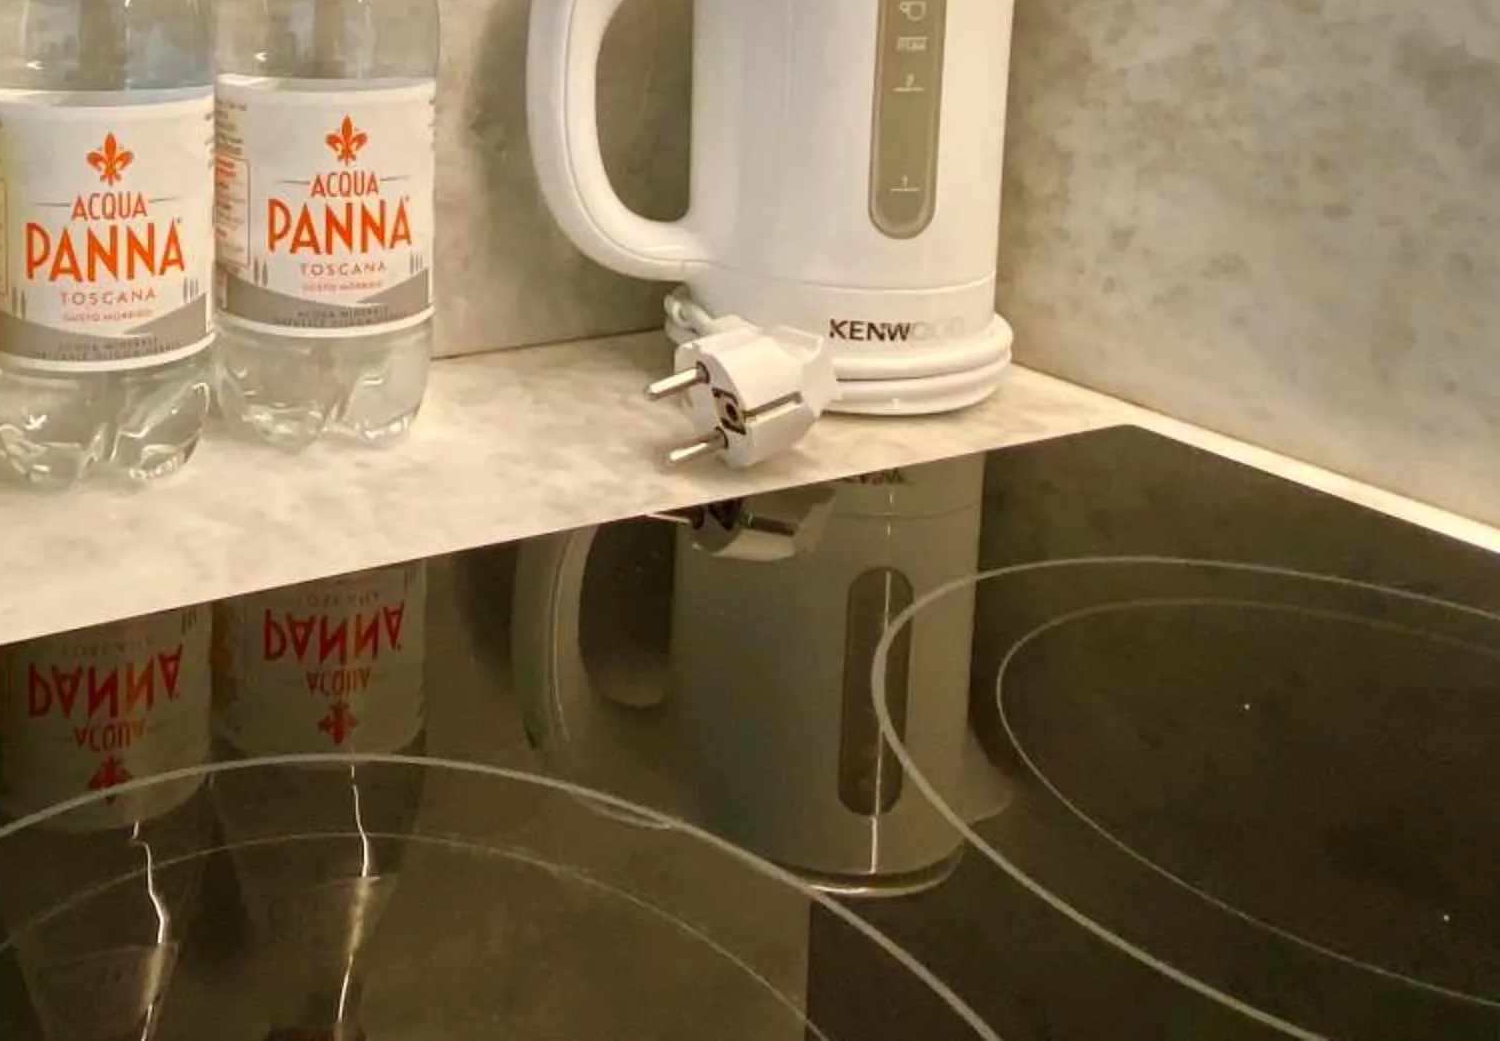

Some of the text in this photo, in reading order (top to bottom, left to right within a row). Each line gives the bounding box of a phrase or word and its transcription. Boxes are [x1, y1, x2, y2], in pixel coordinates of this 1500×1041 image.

[310, 171, 380, 199] ACQUA
[71, 192, 147, 221] ACQUA
[266, 196, 412, 256] PANNA
[25, 219, 185, 283] PANNA
[301, 261, 388, 277] TOSCANA
[60, 287, 157, 307] TOSCANA
